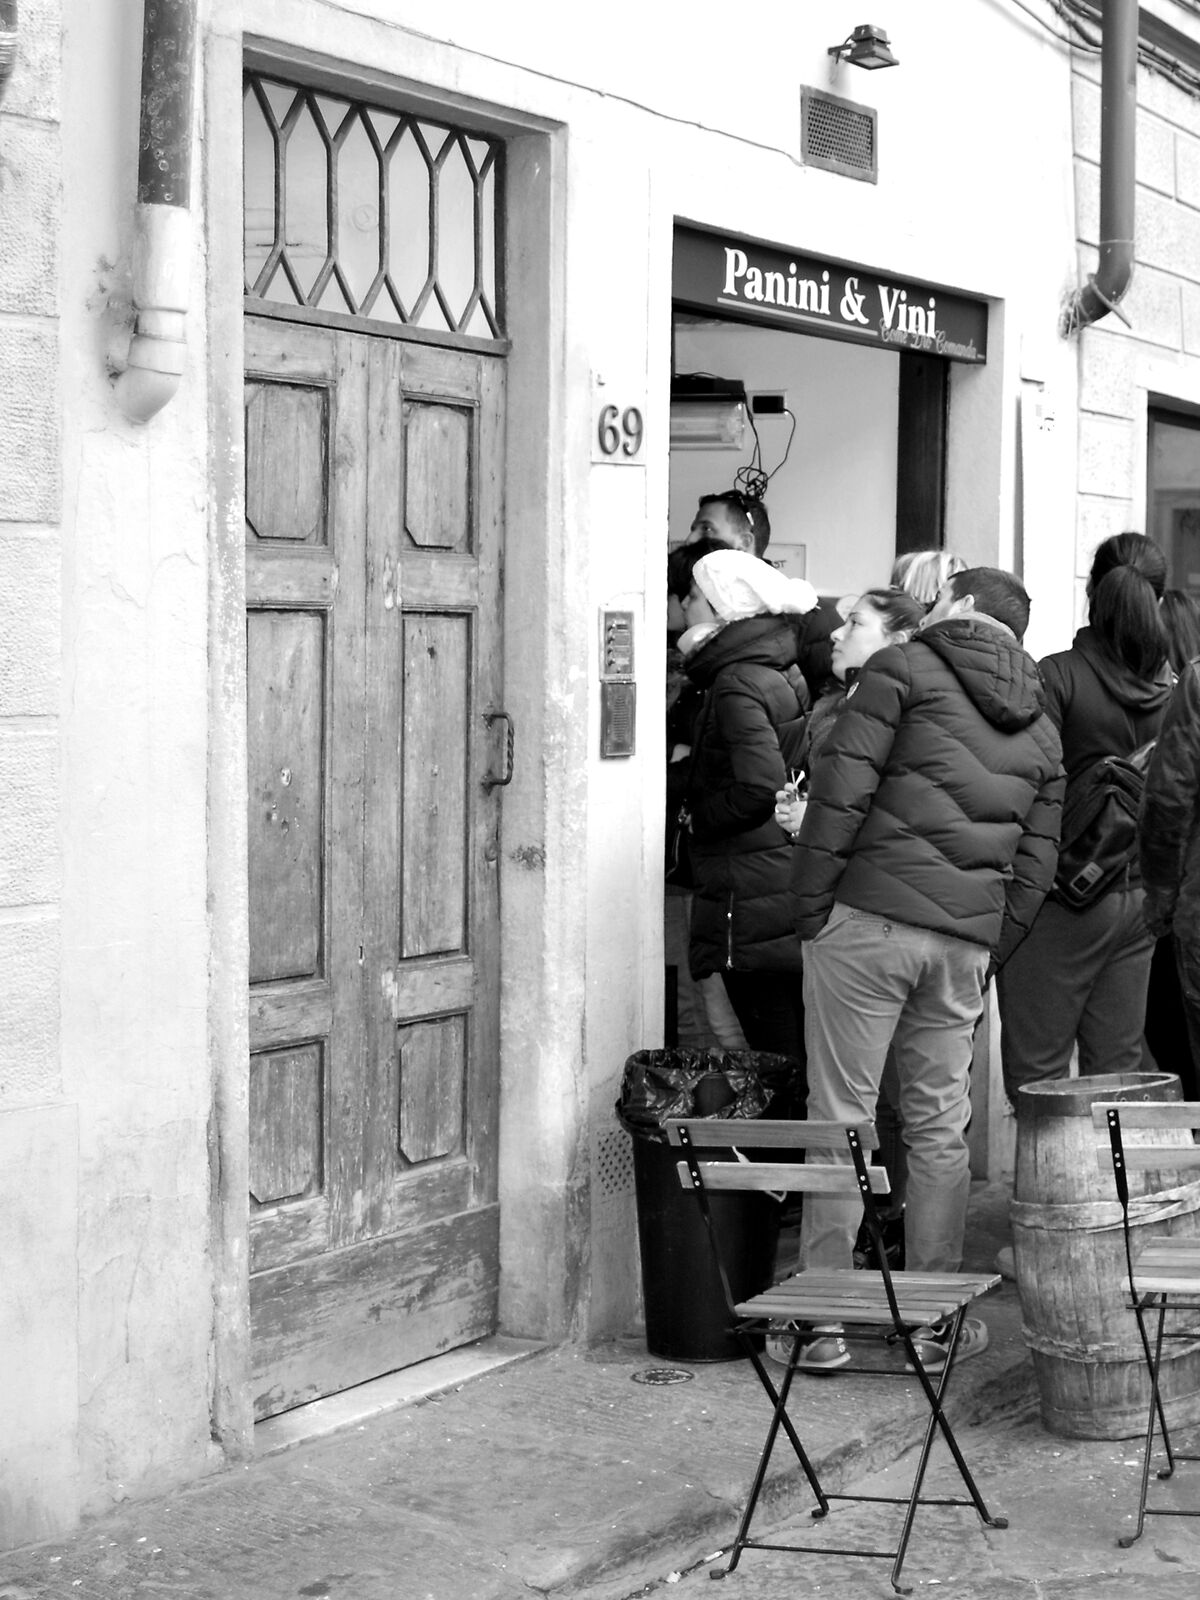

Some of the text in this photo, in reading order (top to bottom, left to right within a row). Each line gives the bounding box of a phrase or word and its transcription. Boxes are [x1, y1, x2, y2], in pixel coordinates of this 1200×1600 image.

[723, 246, 936, 339] Panini & Vini
[599, 404, 643, 456] 69
